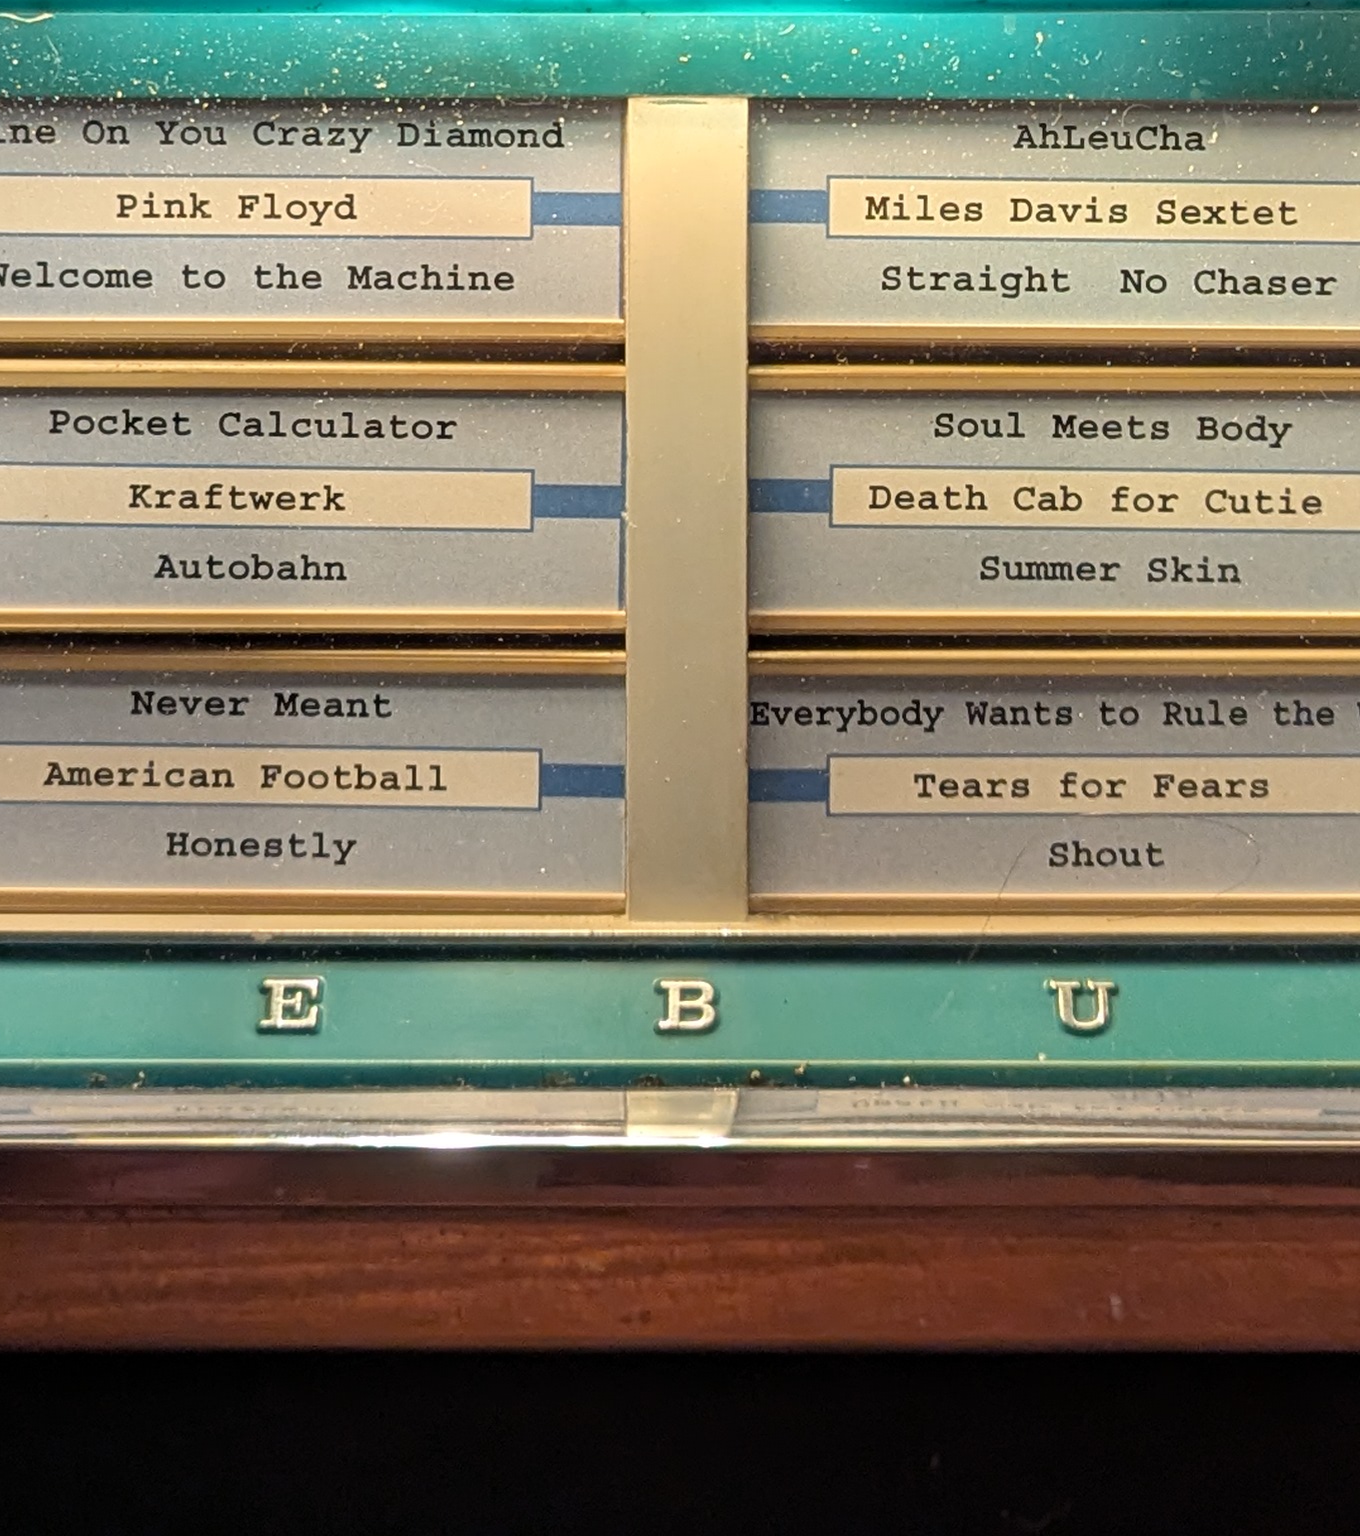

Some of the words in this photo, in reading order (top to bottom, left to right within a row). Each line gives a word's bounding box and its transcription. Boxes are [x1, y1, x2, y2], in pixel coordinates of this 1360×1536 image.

[82, 120, 130, 145] On
[155, 120, 227, 146] You
[252, 121, 373, 154] Crazy
[396, 122, 565, 149] Diamond
[1012, 122, 1206, 152] AhLeuCha
[116, 192, 212, 219] Pink
[238, 192, 358, 227] Floyd
[865, 194, 983, 222] Miles
[1009, 198, 1128, 224] Davis
[1156, 199, 1298, 226] Sextet
[934, 411, 1026, 438] Soul
[1052, 414, 1170, 441] Meets
[1196, 415, 1293, 449] Body
[128, 483, 346, 511] Kraftwerk
[153, 553, 347, 581] Autobahn
[980, 555, 1121, 582] Summer
[1147, 556, 1241, 583] Skin
[130, 691, 250, 716] Never
[274, 692, 392, 719] Meant
[750, 699, 945, 733] Everybody
[965, 701, 1073, 726] Wants
[1099, 701, 1140, 727] to
[1162, 699, 1248, 727] Rule
[1273, 700, 1335, 727] the
[43, 762, 235, 788] American
[260, 763, 447, 791] Football
[166, 832, 357, 866] Honestly
